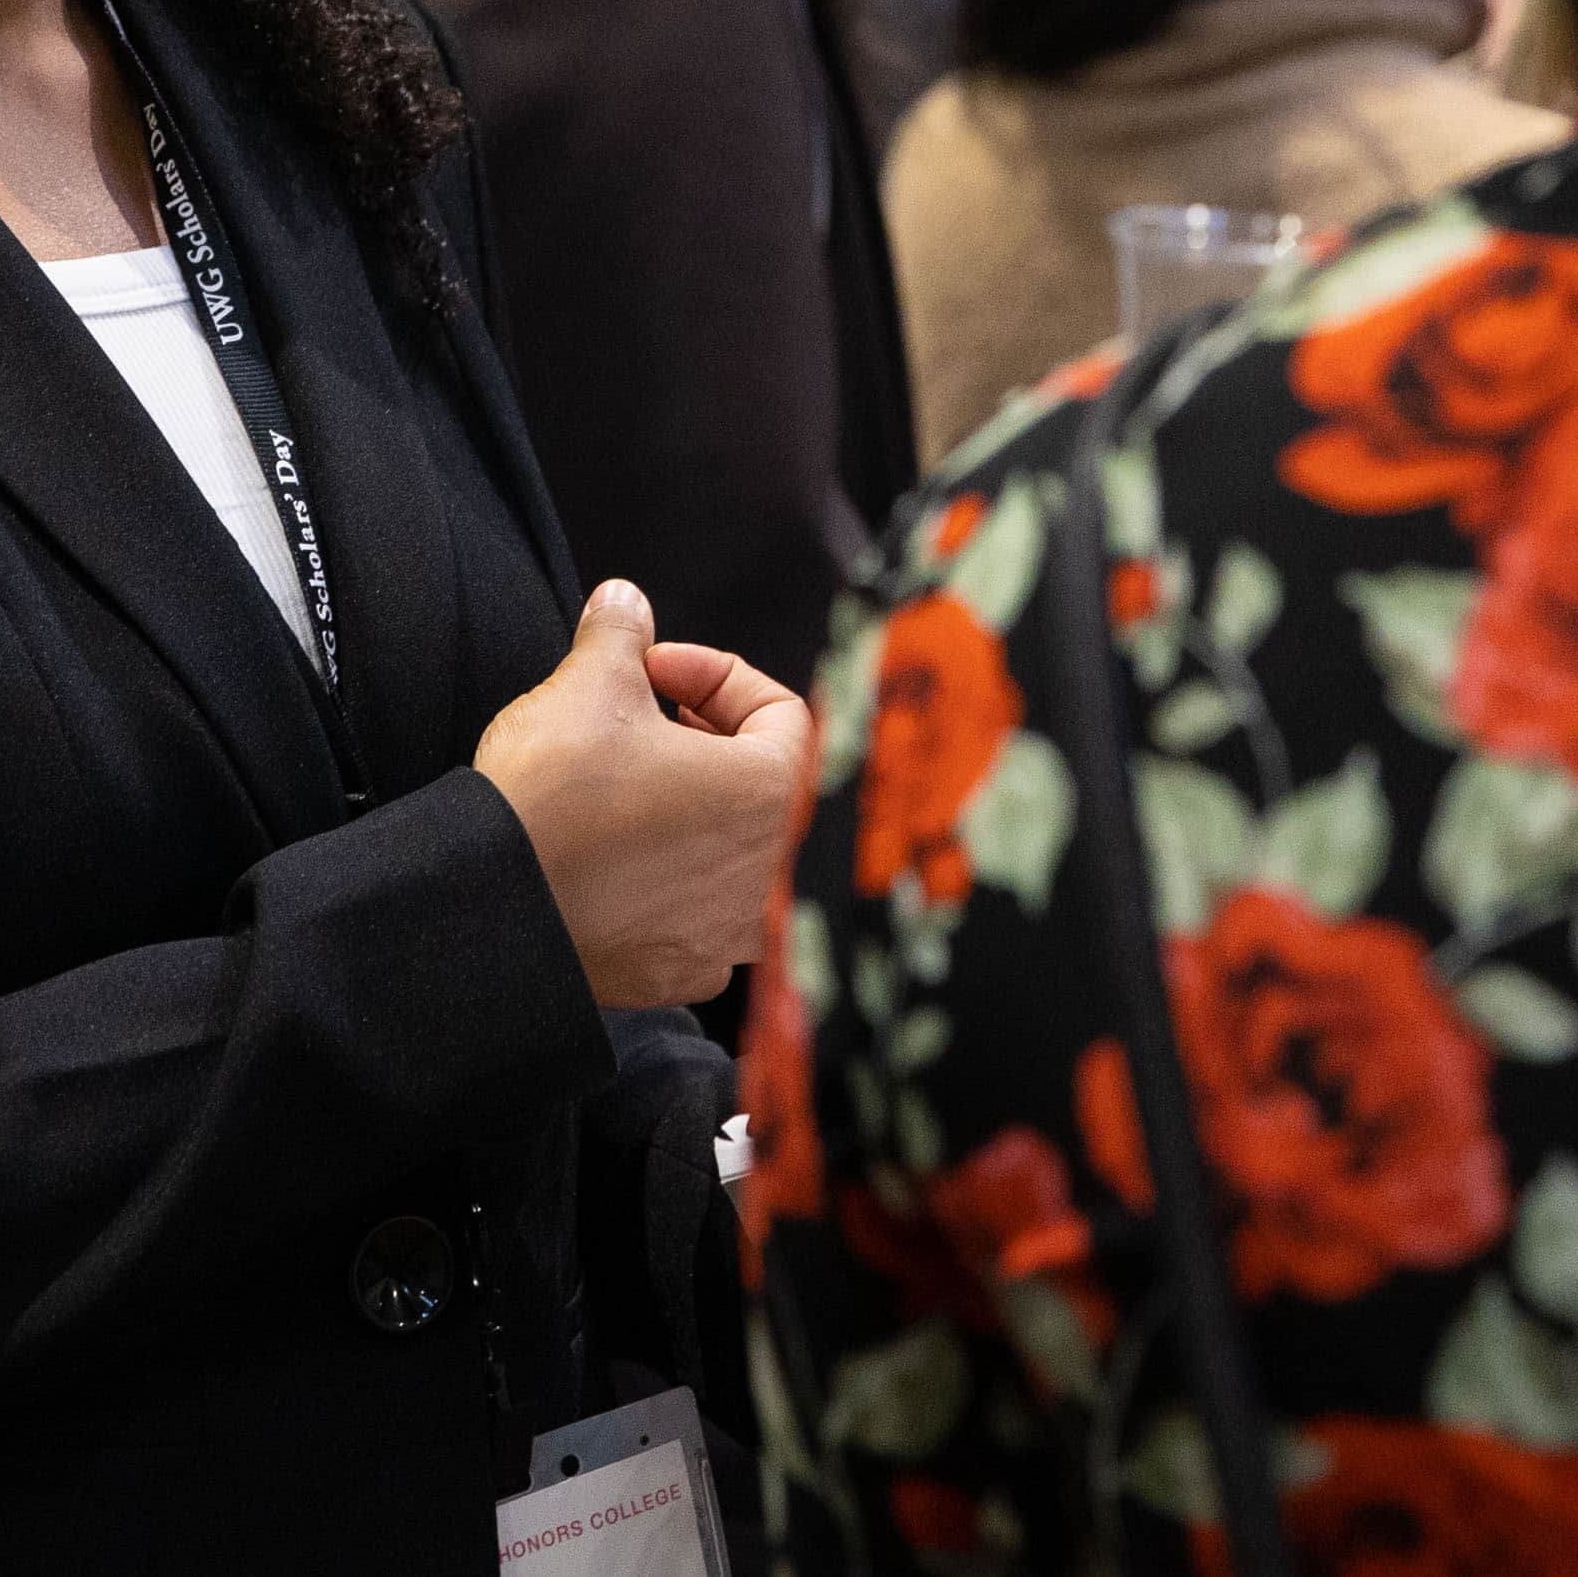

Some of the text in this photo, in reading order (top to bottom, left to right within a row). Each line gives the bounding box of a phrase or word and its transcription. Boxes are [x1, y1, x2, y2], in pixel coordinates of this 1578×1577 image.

[143, 102, 167, 159] Day
[196, 267, 243, 345] UWG
[269, 429, 299, 487] Day
[284, 493, 333, 623] Scholars'
[498, 1483, 682, 1565] HONORS COLLEGE
